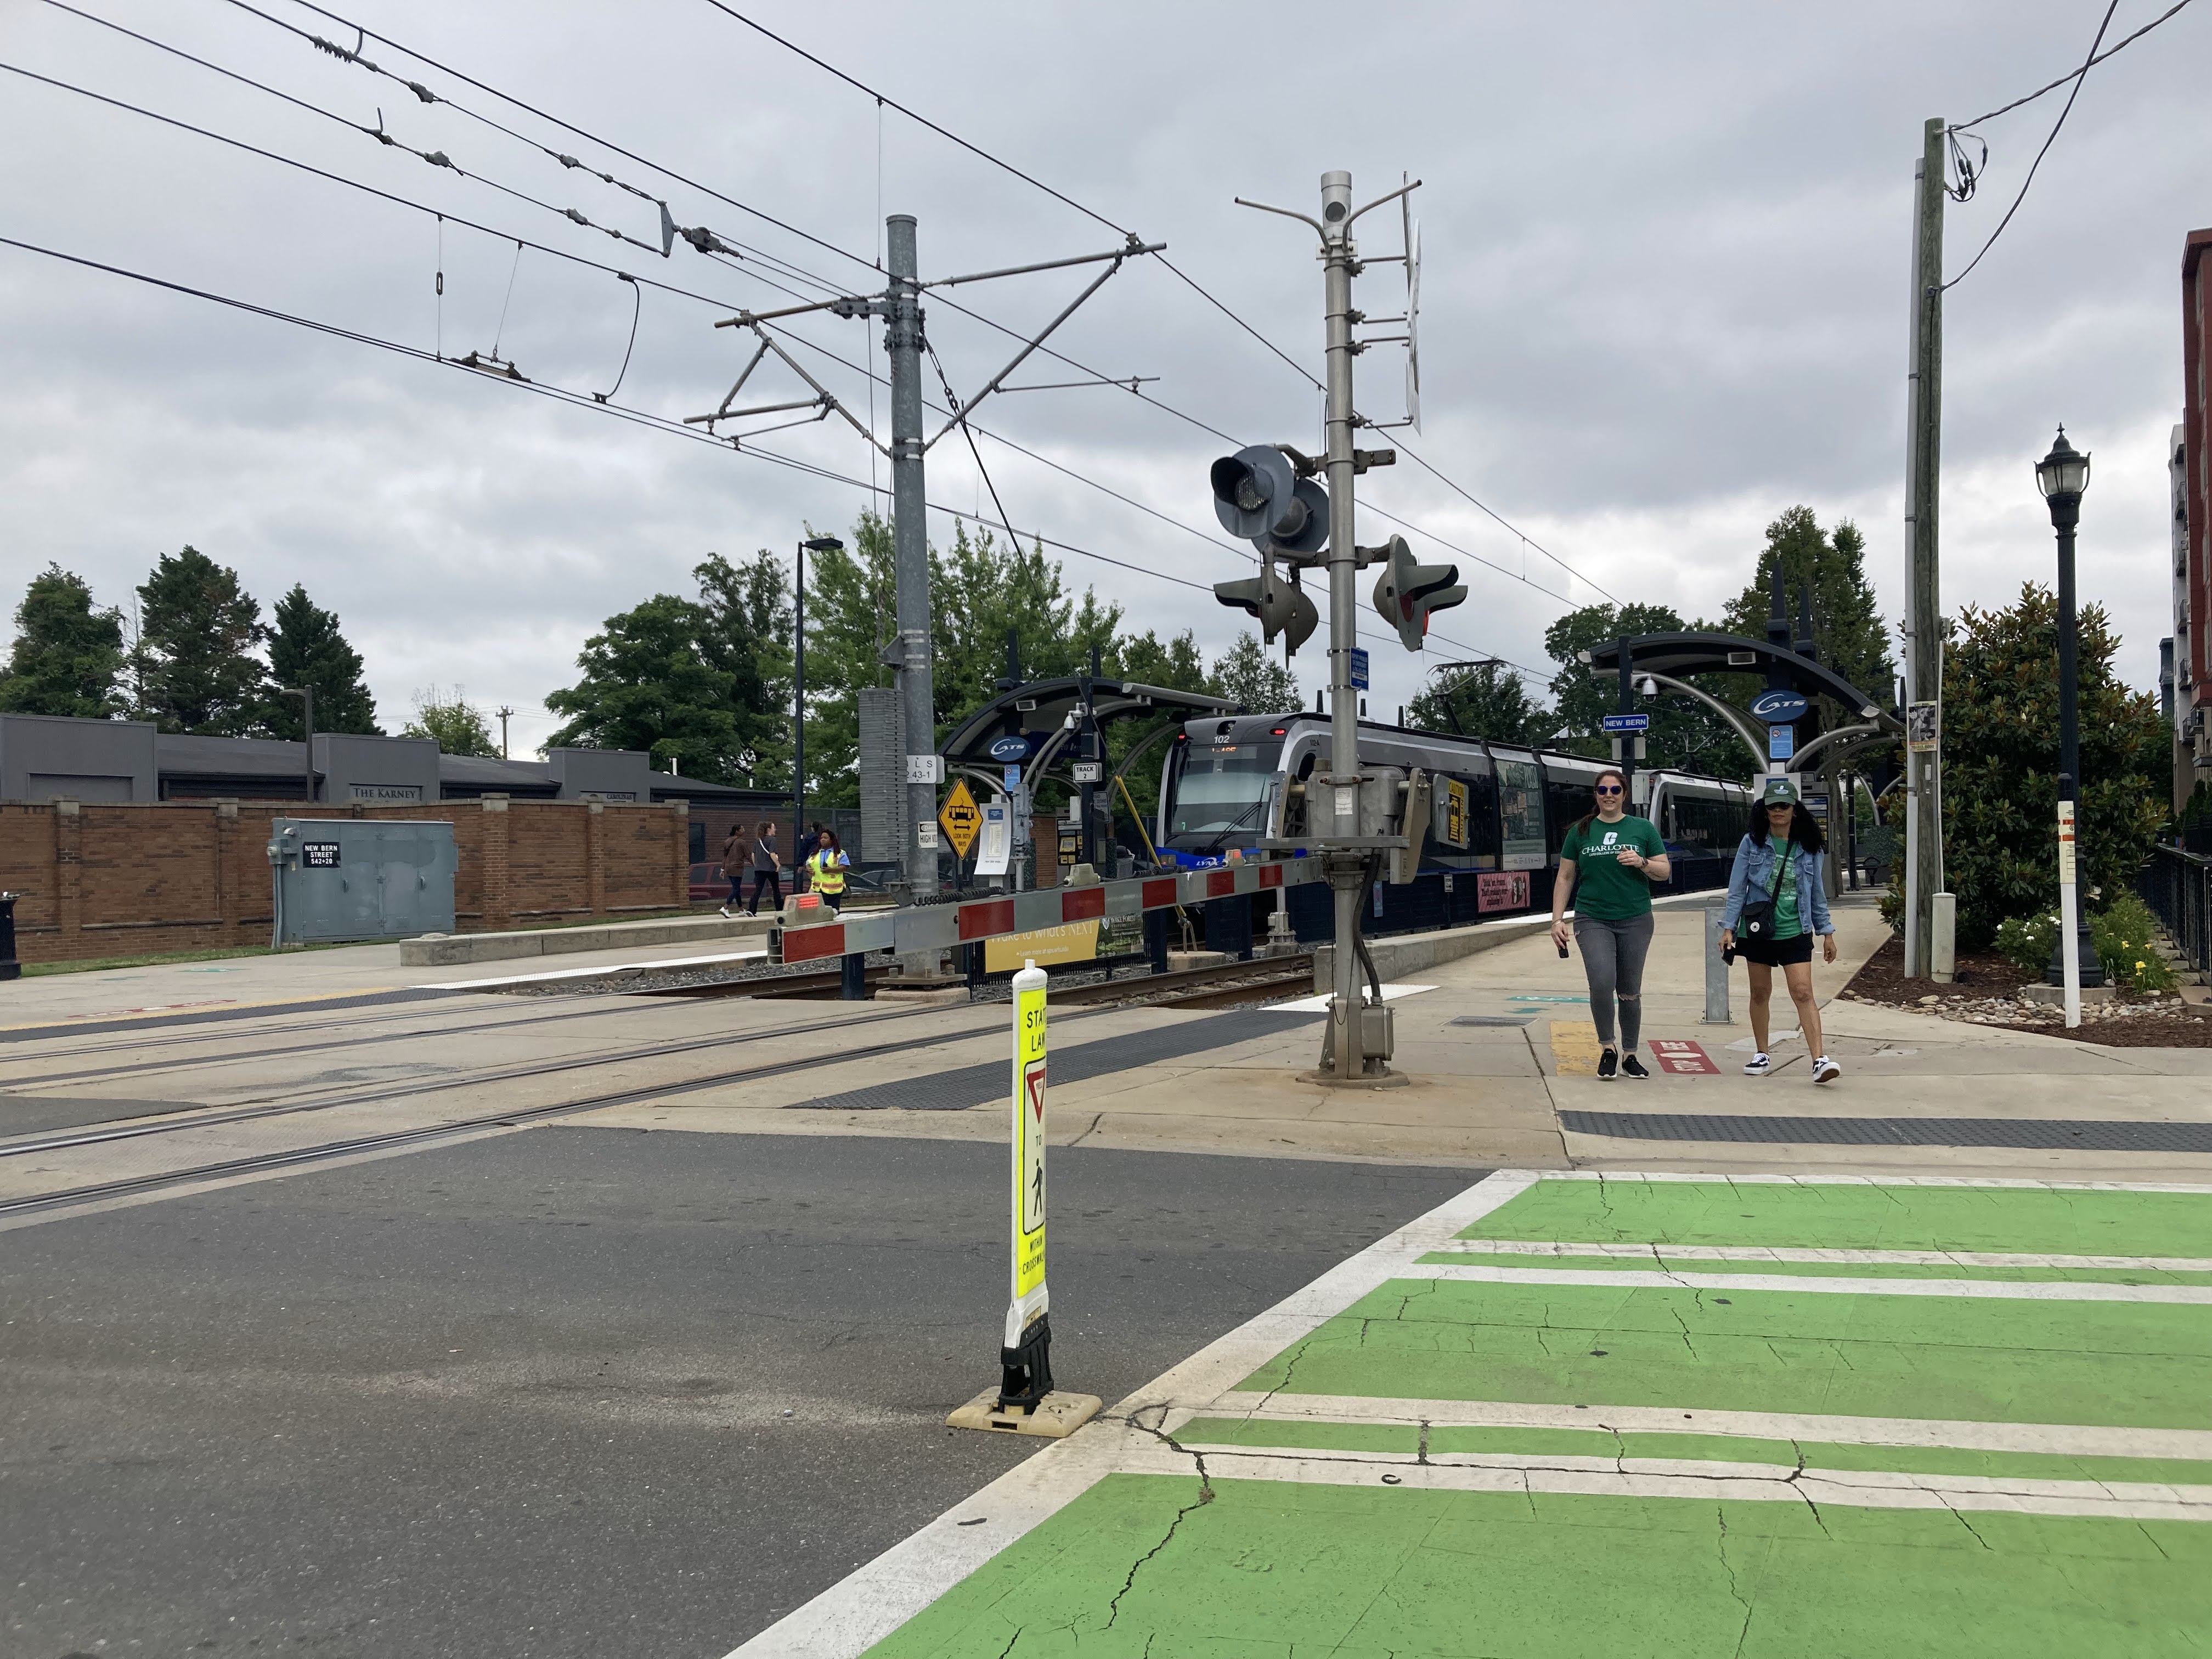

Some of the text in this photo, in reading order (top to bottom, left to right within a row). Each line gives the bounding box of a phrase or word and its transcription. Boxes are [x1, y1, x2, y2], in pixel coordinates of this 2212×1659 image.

[1753, 693, 1806, 714] CATS
[990, 738, 1025, 755] CATS
[1214, 736, 1230, 744] 102
[354, 788, 416, 799] THE KARNEY
[919, 834, 931, 843] HIGH
[1582, 844, 1640, 855] CHARLOTTE
[1070, 921, 1094, 935] NEXT
[1036, 1134, 1042, 1148] TO
[1030, 1234, 1043, 1253] WITHIN
